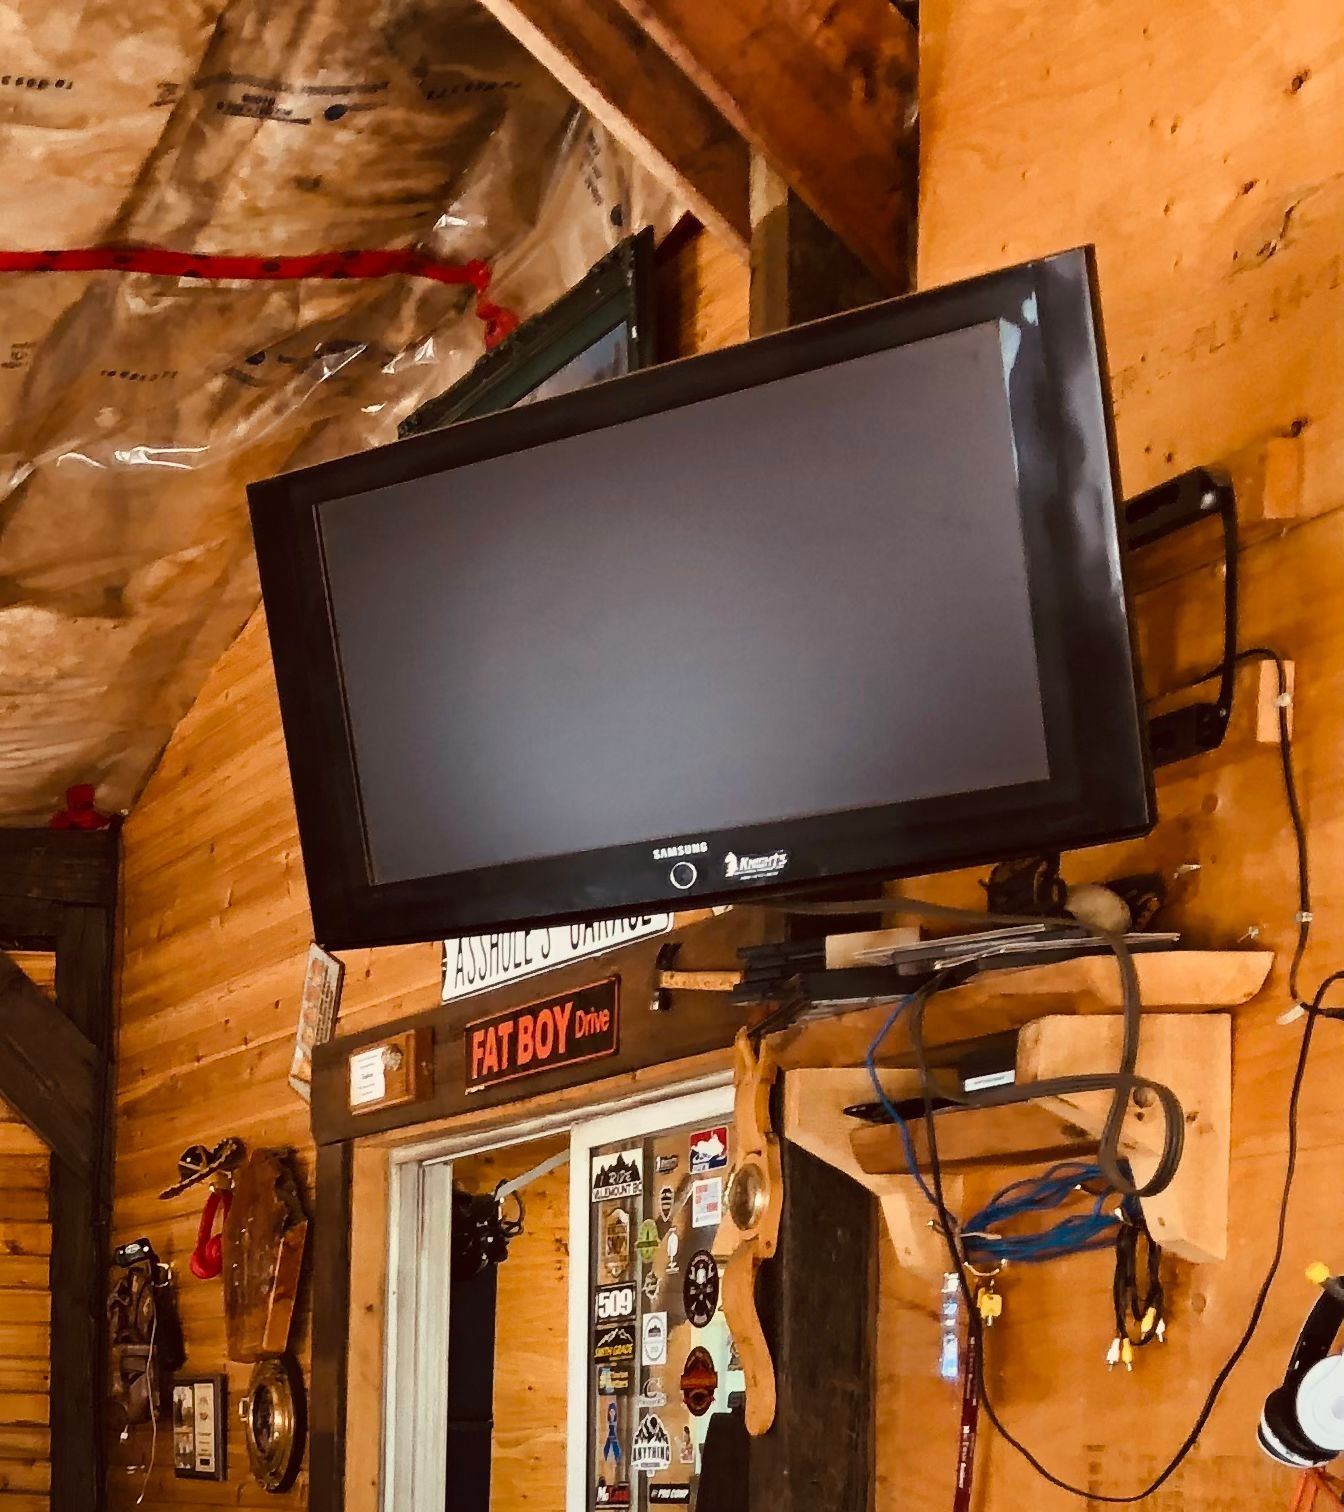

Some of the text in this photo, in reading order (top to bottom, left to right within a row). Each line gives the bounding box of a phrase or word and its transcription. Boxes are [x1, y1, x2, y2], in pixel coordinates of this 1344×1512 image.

[652, 841, 708, 860] SAMSUNG
[471, 1001, 610, 1080] FAT BOY Drive
[598, 1289, 633, 1318] 509
